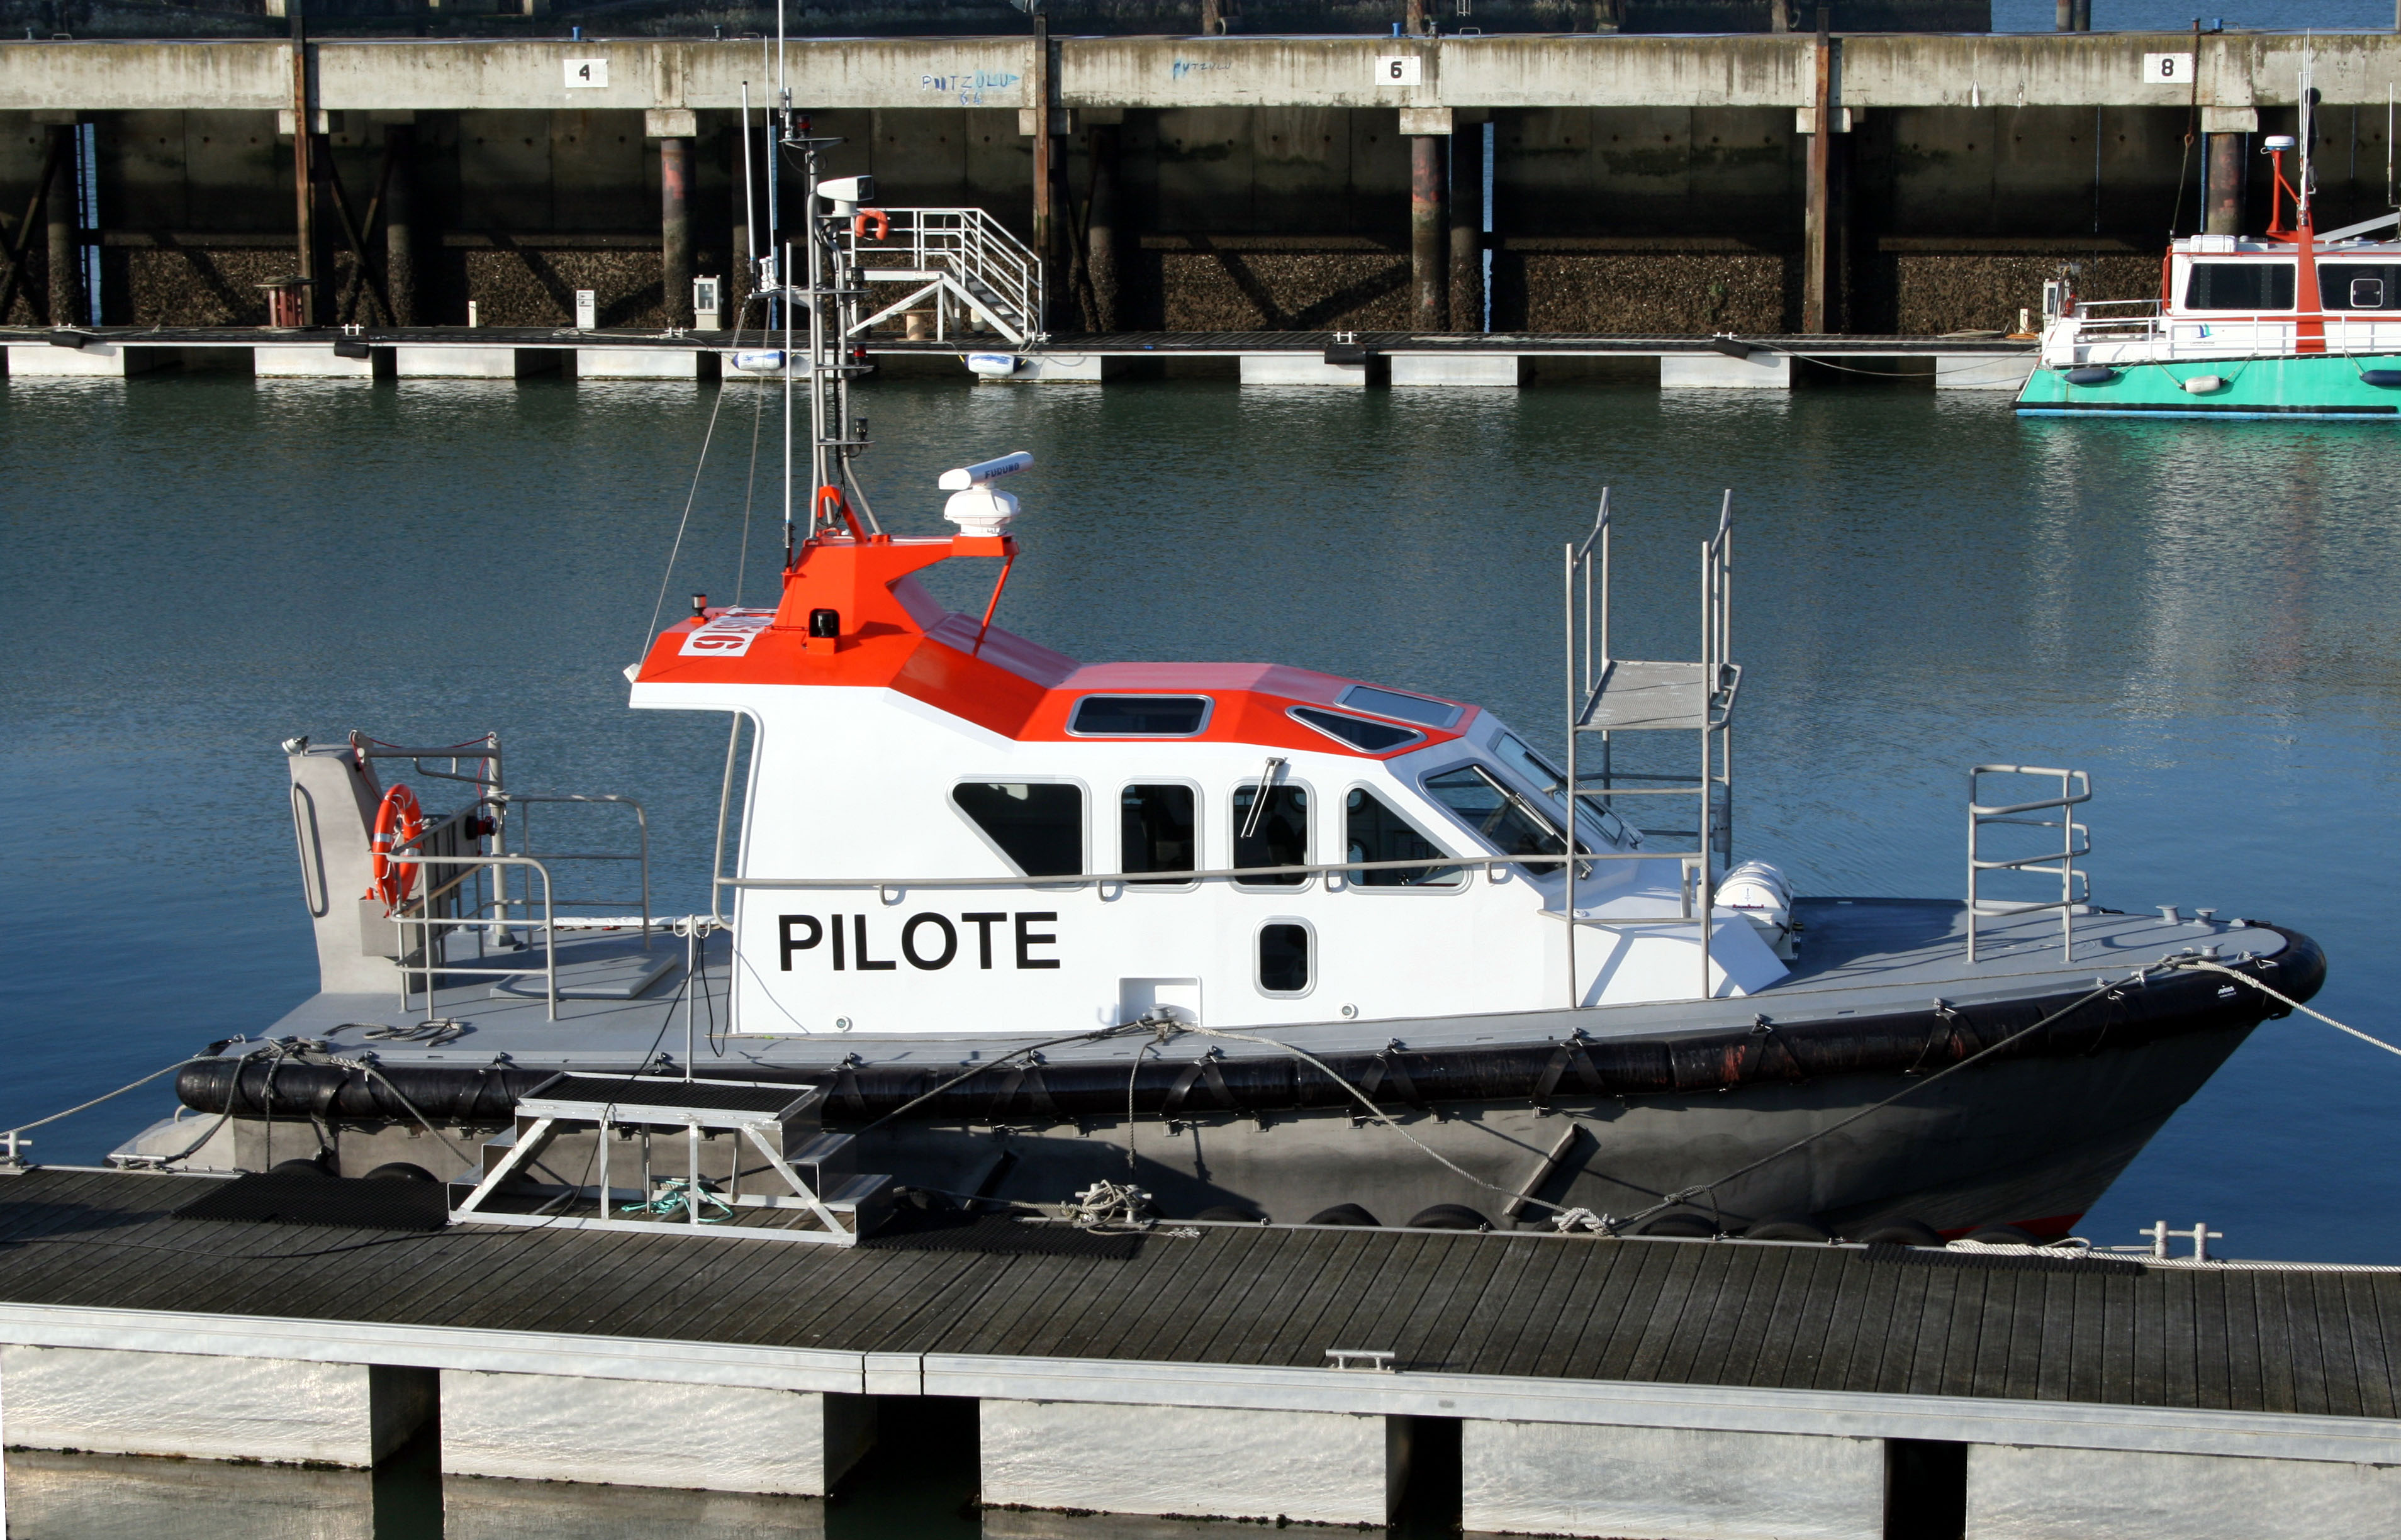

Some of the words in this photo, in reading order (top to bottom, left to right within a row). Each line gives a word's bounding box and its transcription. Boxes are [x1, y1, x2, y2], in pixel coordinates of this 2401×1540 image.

[579, 64, 590, 81] 4
[1391, 61, 1402, 79] 6
[2162, 59, 2174, 77] 8
[985, 462, 1019, 479] FURUNO
[779, 912, 1060, 971] PILOTE
